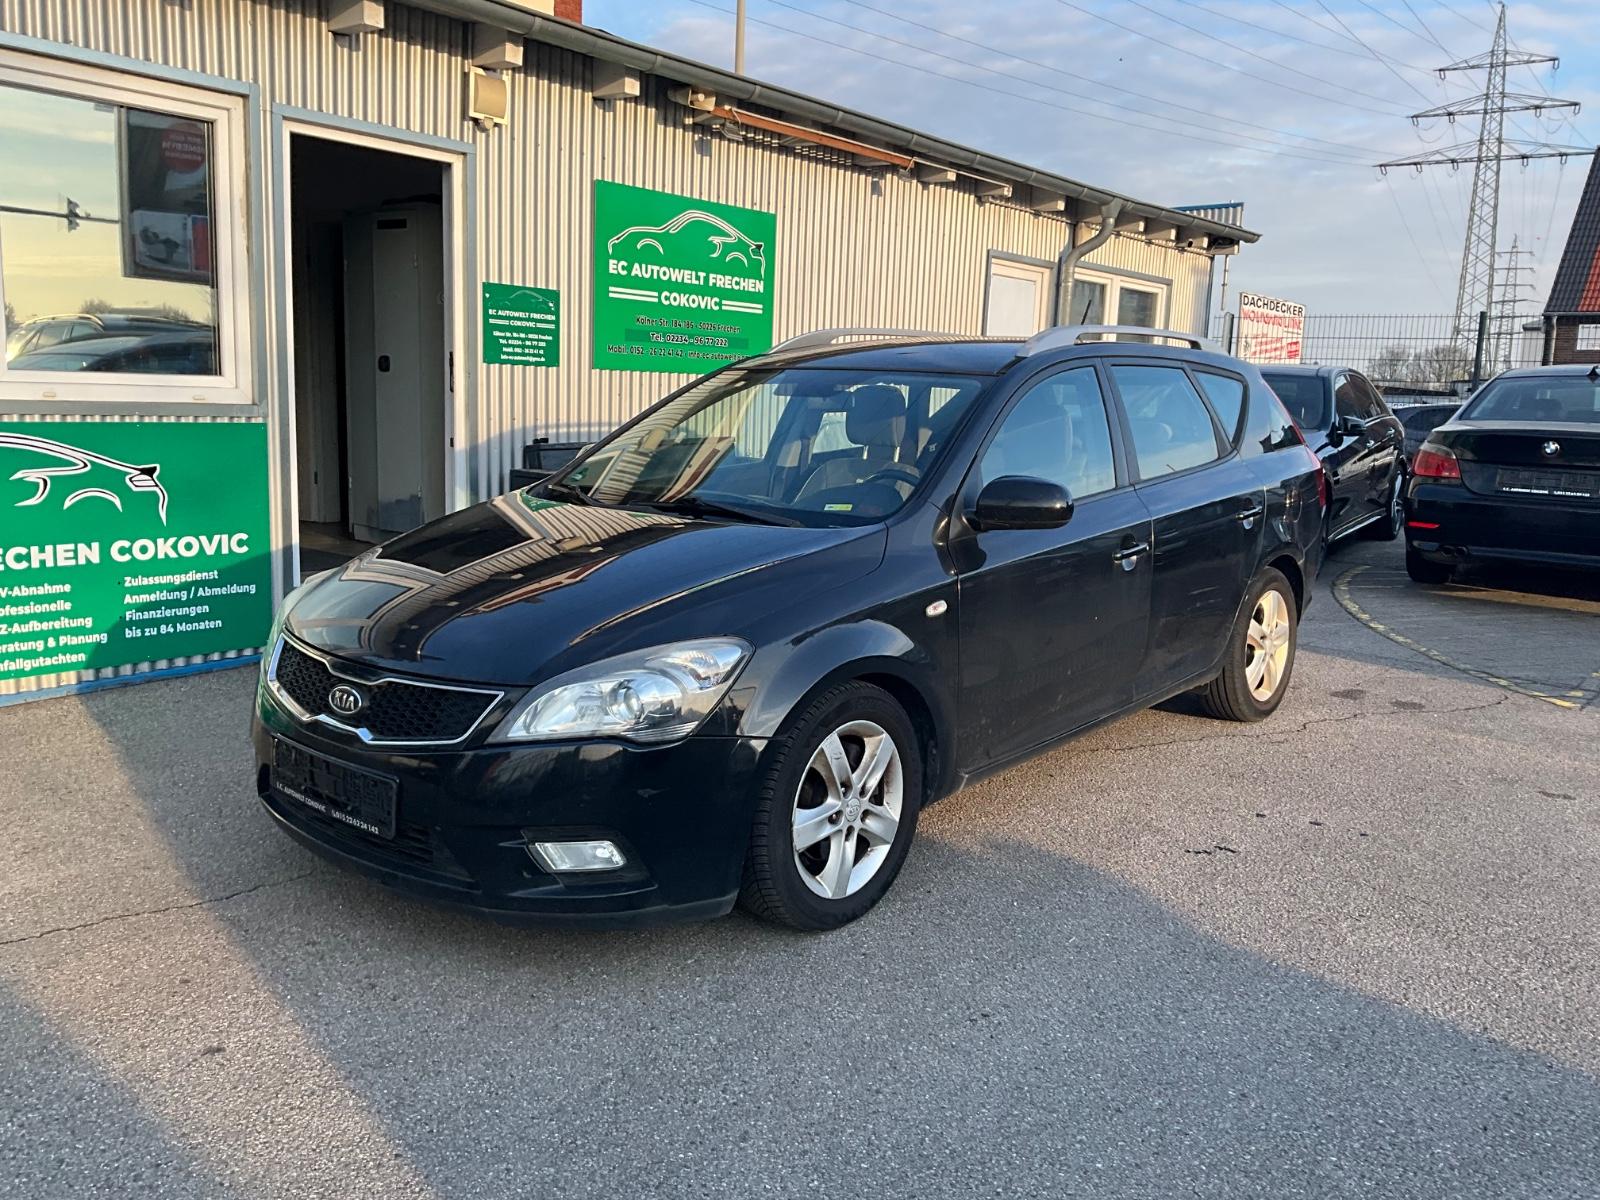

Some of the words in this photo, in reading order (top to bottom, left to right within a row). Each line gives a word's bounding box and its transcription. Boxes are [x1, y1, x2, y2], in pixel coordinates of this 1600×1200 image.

[608, 259, 628, 276] EC
[631, 262, 706, 285] AUTOWELT
[709, 274, 764, 293] FRECHEN
[661, 291, 720, 310] COKOVIC
[1243, 295, 1303, 317] DACHDECKER
[650, 332, 664, 342] Tel.
[666, 334, 688, 344] 02234
[694, 335, 704, 345] 96
[705, 336, 713, 345] 77
[717, 324, 741, 334] Frechen
[630, 346, 644, 355] 0152
[0, 542, 100, 571] CHEN
[110, 532, 249, 562] COKOVIC
[124, 570, 218, 587] Zulassungsdienst
[124, 589, 187, 604] Anmeldung
[197, 583, 256, 598] Abmeldung
[126, 604, 210, 621] Finanzierungen
[125, 627, 141, 639] bis
[145, 627, 157, 636] zu
[160, 624, 174, 634] 84
[177, 619, 222, 633] Monaten
[0, 639, 44, 652] ratung
[47, 637, 56, 648] &
[59, 633, 108, 647] Planung
